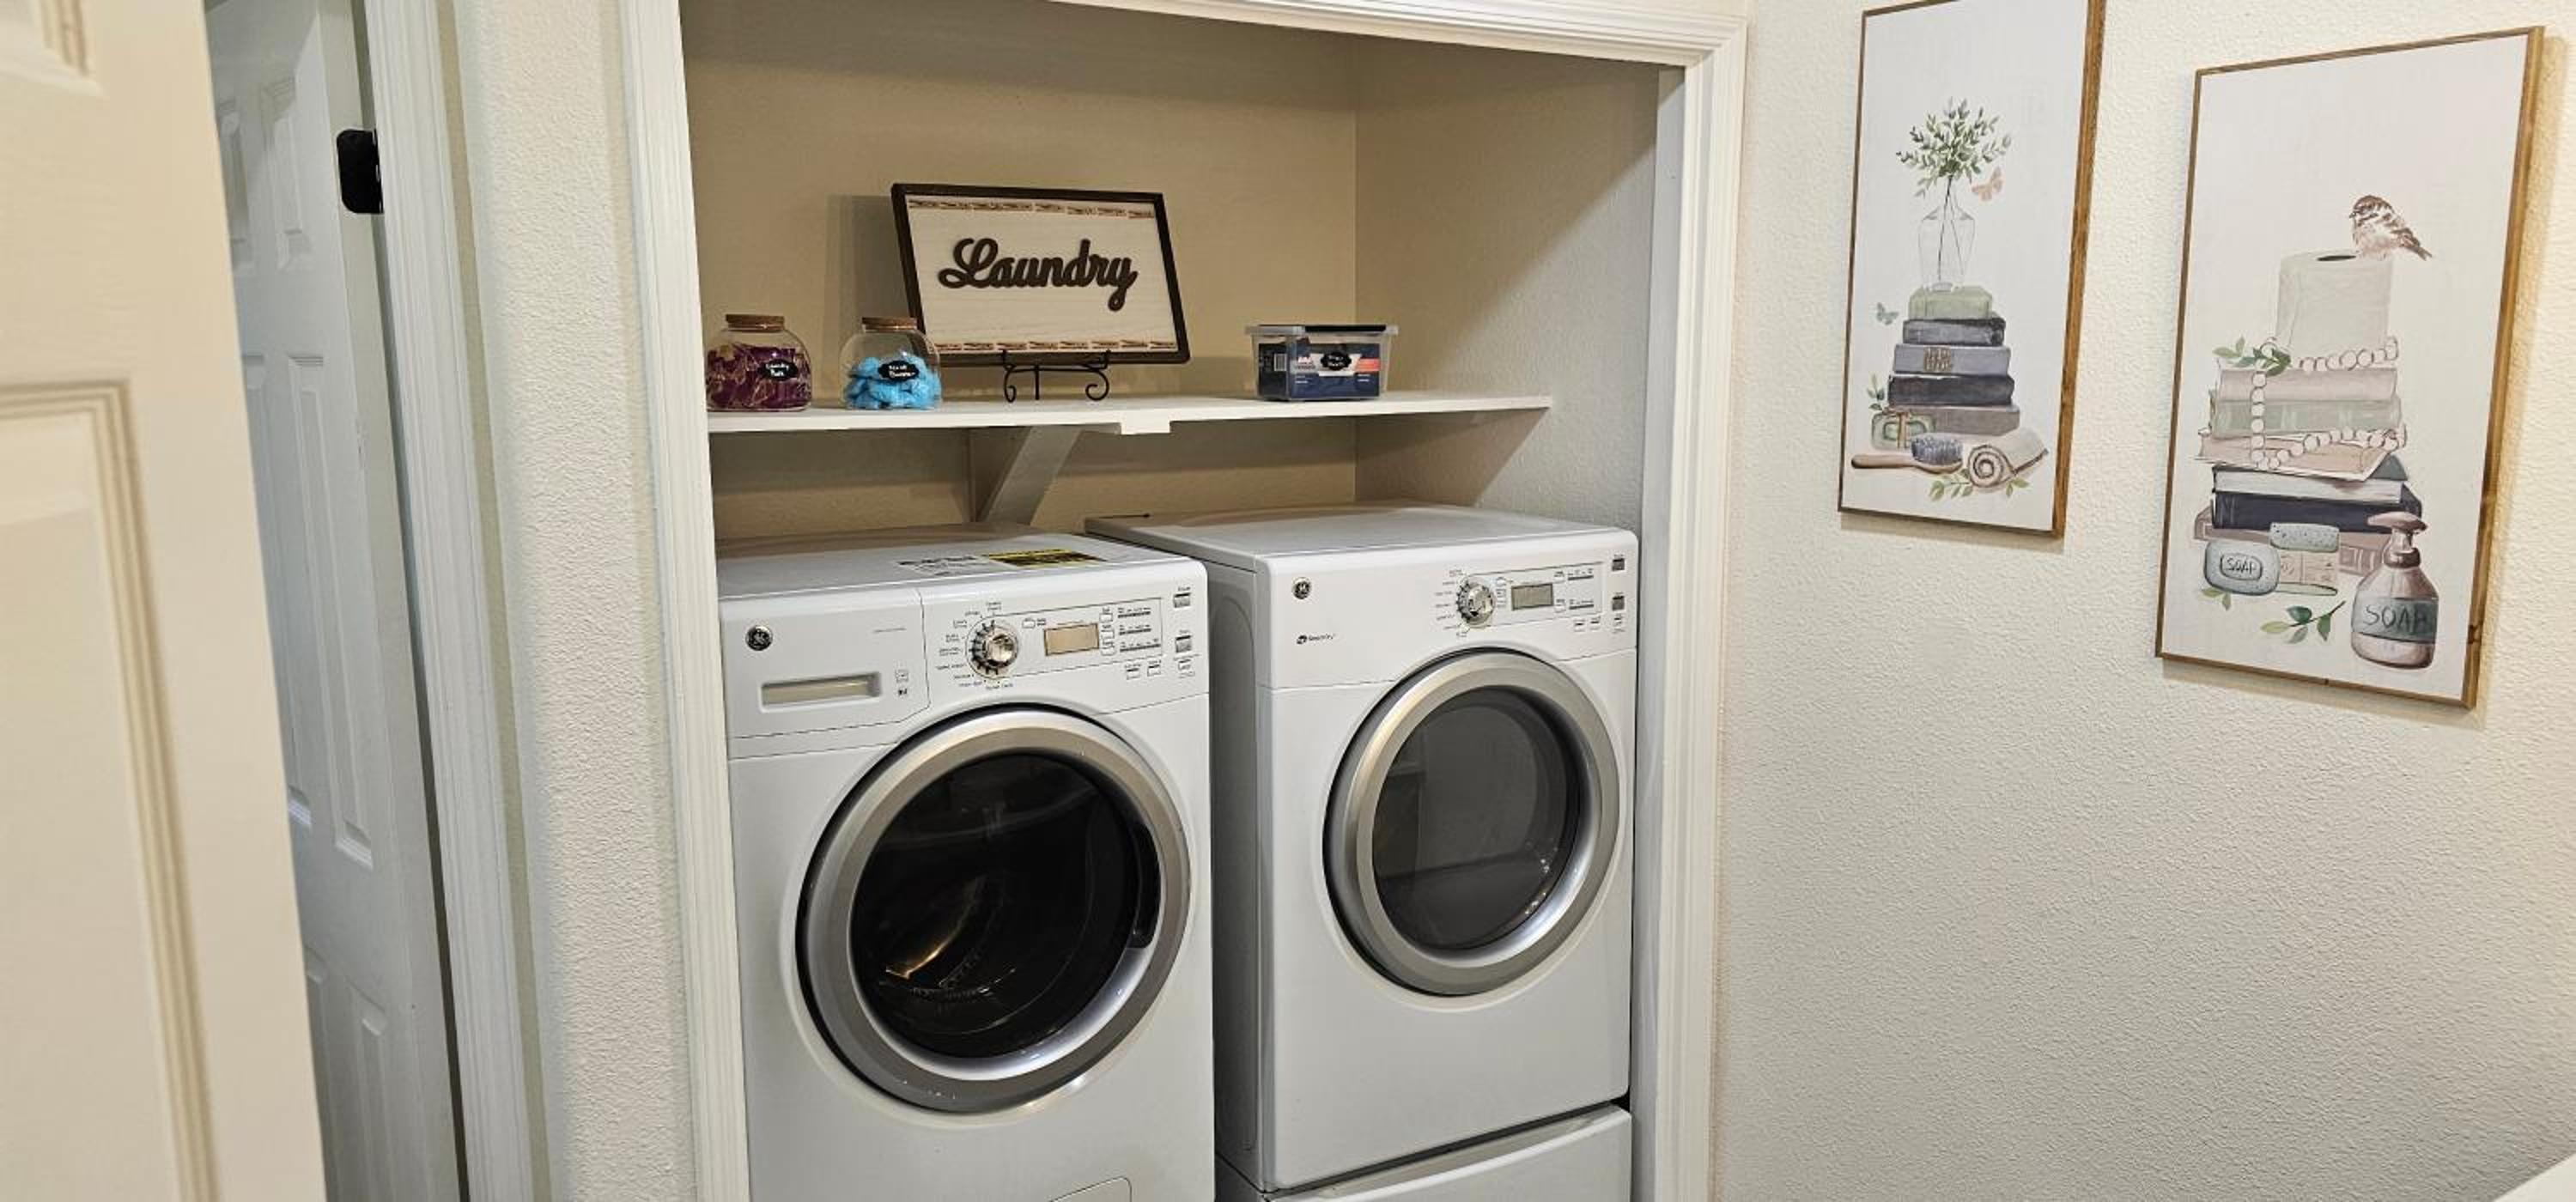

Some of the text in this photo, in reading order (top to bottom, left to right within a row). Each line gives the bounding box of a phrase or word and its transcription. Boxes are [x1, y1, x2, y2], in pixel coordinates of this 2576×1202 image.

[937, 237, 1139, 313] Laundry
[2226, 557, 2257, 574] SOAP
[2363, 604, 2427, 634] SOAP
